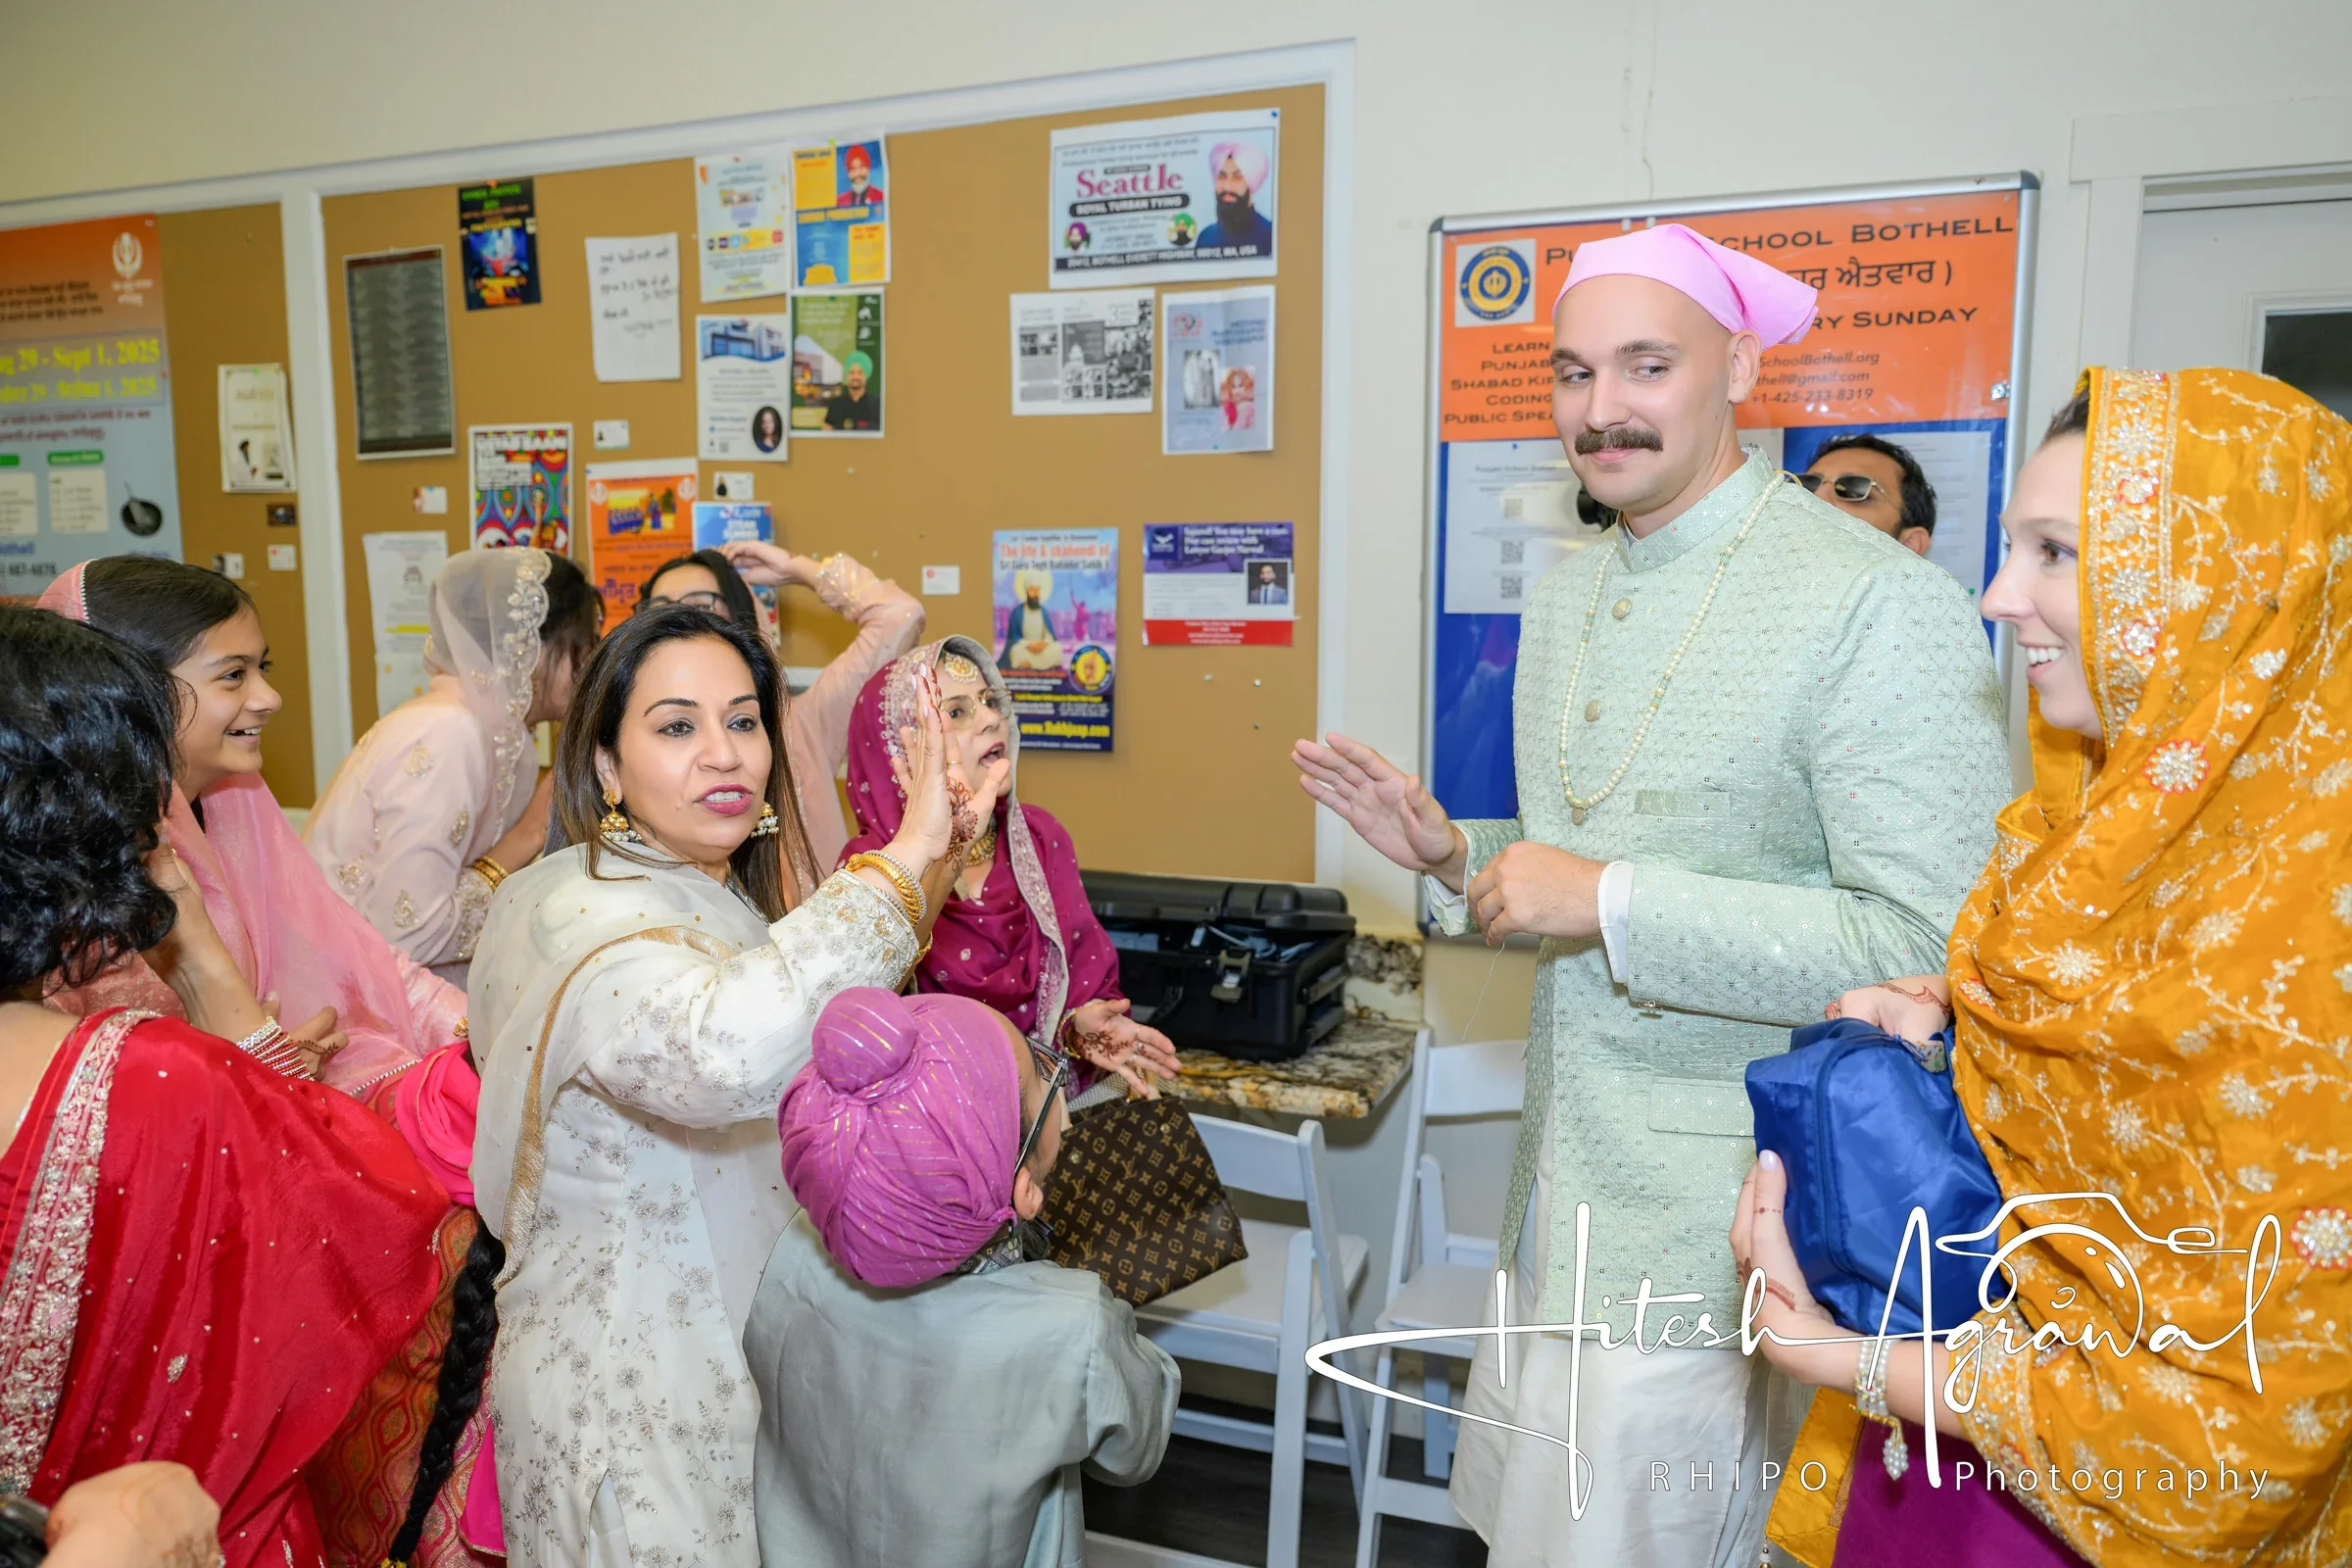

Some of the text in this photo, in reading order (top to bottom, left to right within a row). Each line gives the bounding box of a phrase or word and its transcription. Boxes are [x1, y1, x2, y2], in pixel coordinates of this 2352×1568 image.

[1075, 163, 1183, 199] Seattle
[1075, 196, 1182, 216] ROYAL TURBAN TYING
[1710, 217, 2013, 251] CHOOL BOTHELL
[1852, 307, 1979, 329] SUNDAY
[18, 348, 38, 371] 29
[53, 346, 91, 373] Sept
[117, 338, 161, 365] 2025
[1493, 342, 1550, 354] LEARN
[1481, 359, 1551, 371] PUNJAB
[1760, 351, 1880, 368] SchoolBothell.org
[1450, 377, 1523, 391] SHABAD
[1756, 370, 1870, 387] thell@gmail.com
[1444, 412, 1506, 424] PUBLIC
[1001, 544, 1017, 558] The
